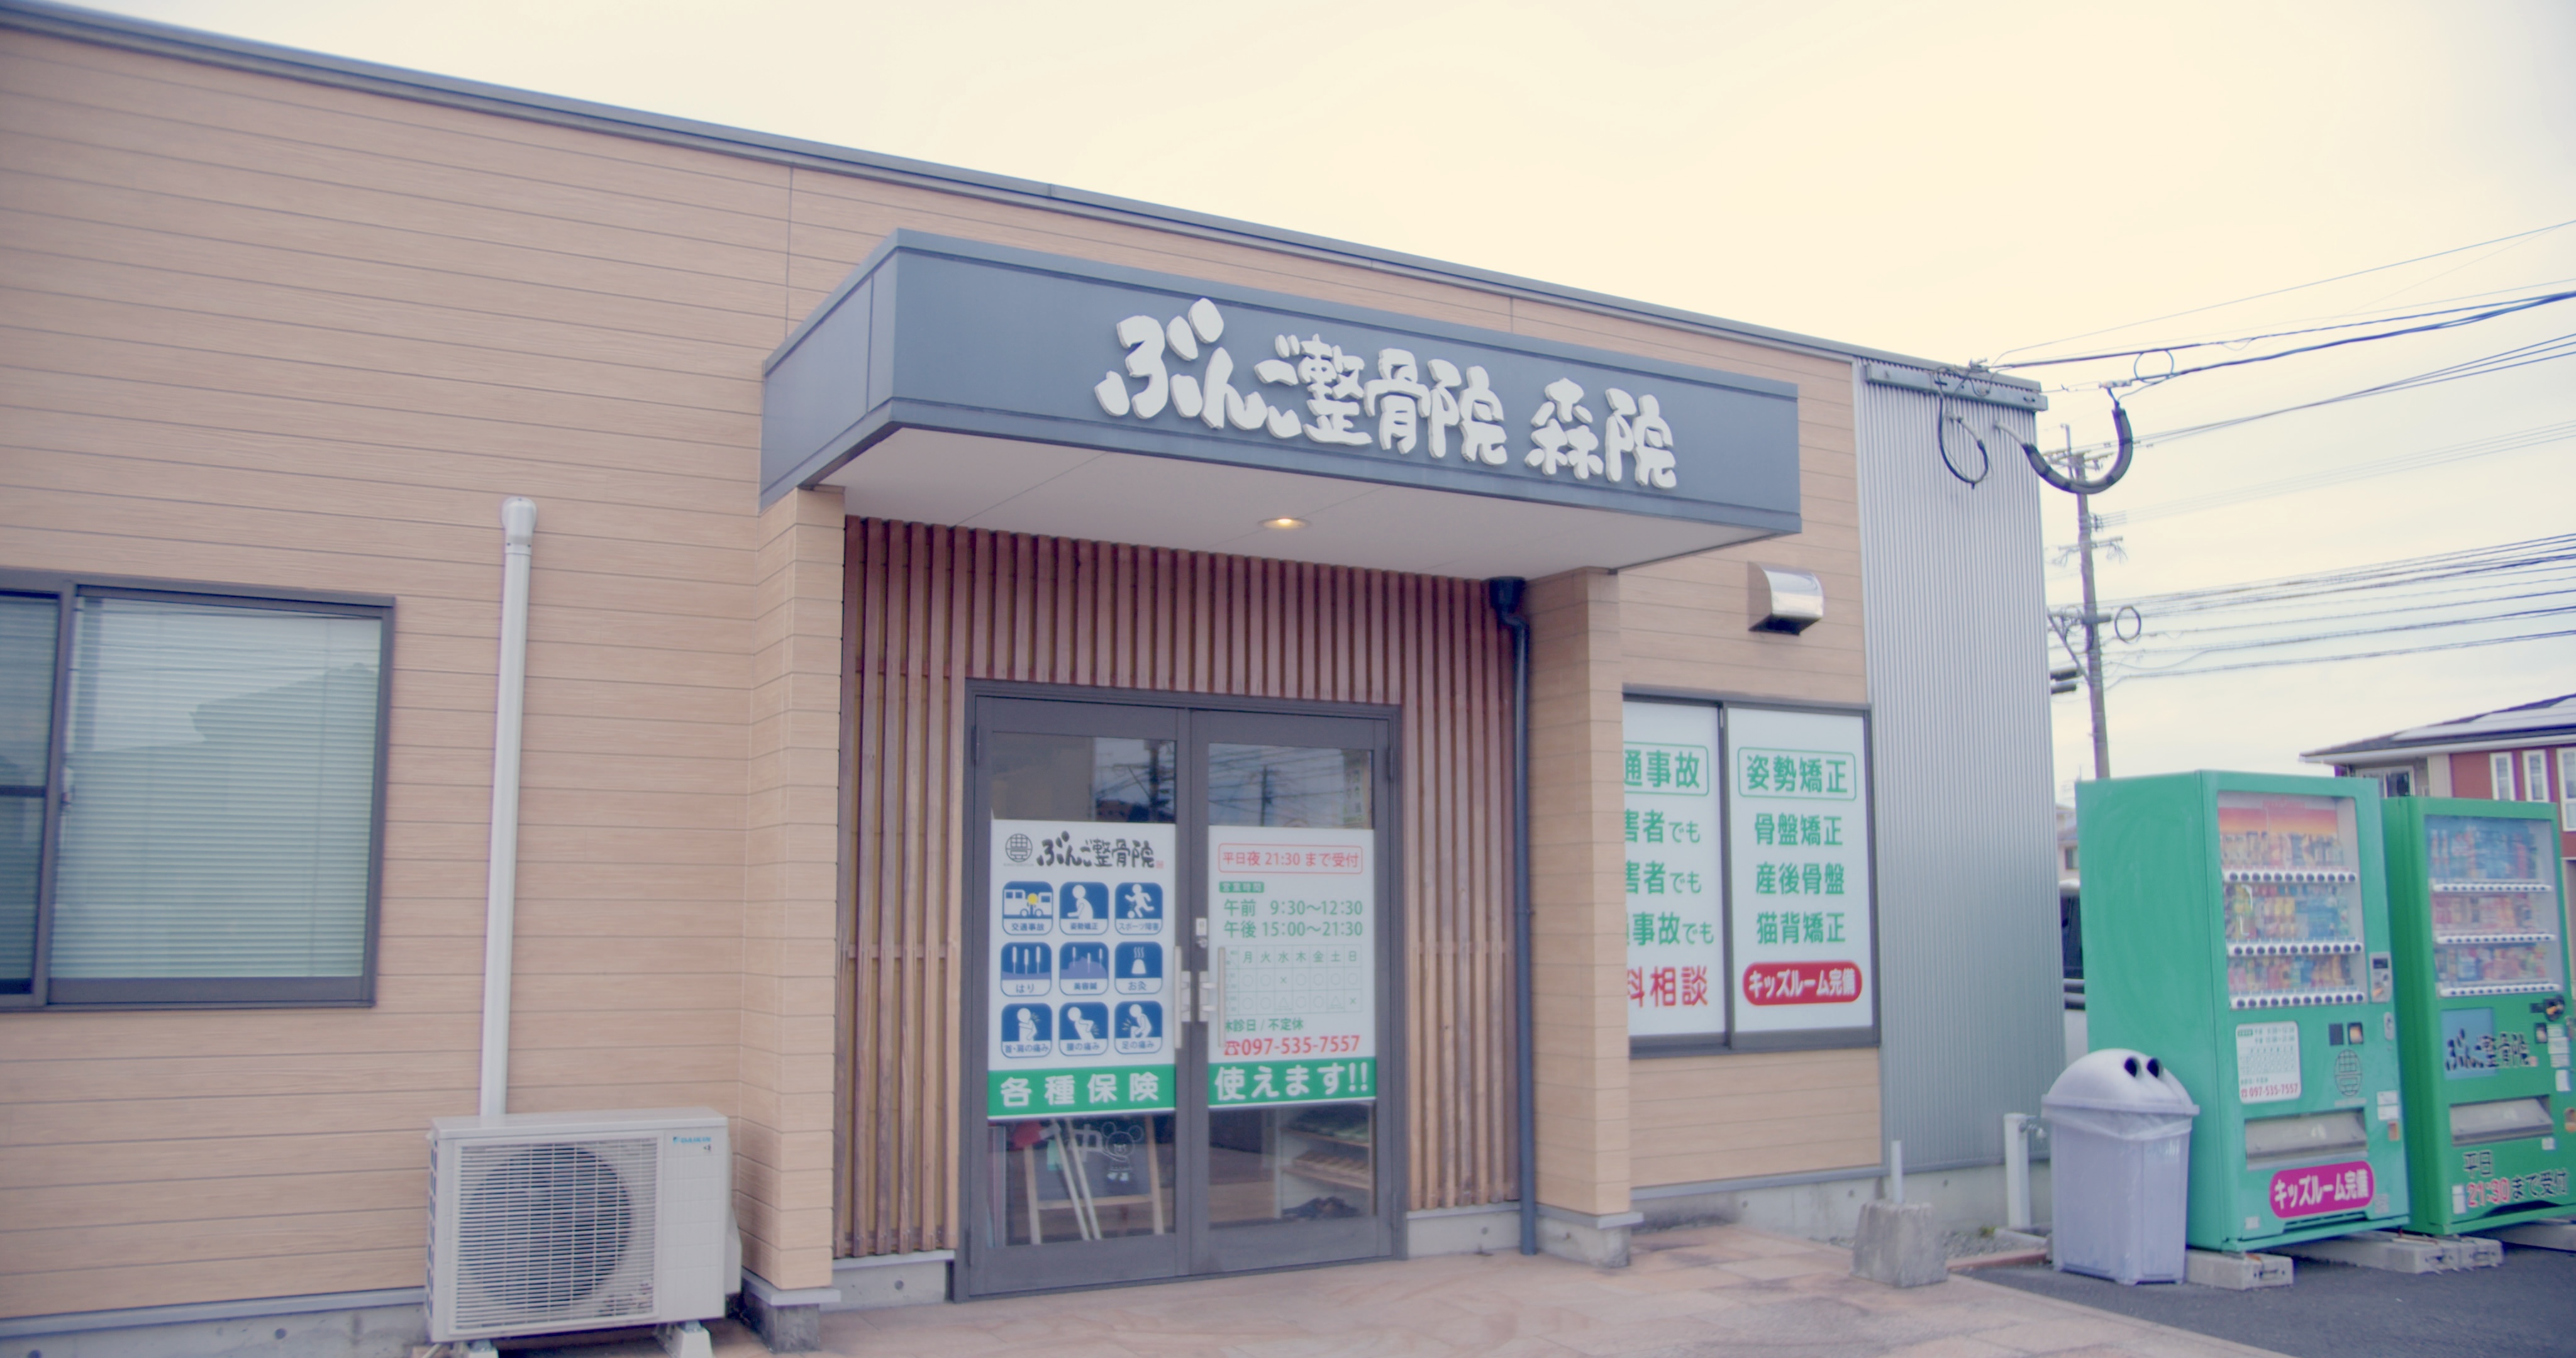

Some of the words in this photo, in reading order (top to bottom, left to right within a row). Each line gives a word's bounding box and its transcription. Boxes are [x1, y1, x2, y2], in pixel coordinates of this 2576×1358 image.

[1094, 297, 1507, 466] ぶんご整骨院
[1524, 378, 1678, 489] 森院
[1624, 749, 1700, 788] 通事故
[1746, 754, 1848, 793] 姿勢矯正
[1755, 813, 1843, 846] 骨盤矯正
[1036, 830, 1155, 868] ぶんご整骨院
[1222, 851, 1261, 867] 平日夜
[1265, 852, 1301, 866] 21:30
[1305, 852, 1360, 868] まで受付
[1755, 861, 1845, 895] 産後骨盤
[1224, 899, 1257, 917] 午前
[1011, 922, 1045, 932] 交通事故
[1224, 920, 1257, 939] 午後
[1626, 911, 1714, 946] 事故でも
[1756, 911, 1846, 945] 猫背矯正
[1243, 951, 1253, 964] 月
[1260, 951, 1271, 963] 火
[1278, 951, 1289, 963] 水
[1296, 951, 1307, 963] 木
[1313, 950, 1324, 963] 金
[1331, 951, 1341, 962] 土
[1348, 950, 1357, 962] 日
[1016, 983, 1035, 993] はり
[1128, 981, 1147, 991] お灸
[1748, 968, 1856, 999] キッズルーム完備
[1268, 1017, 1304, 1032] 不定休
[1122, 1041, 1155, 1050] 足の痛み
[1241, 1035, 1360, 1056] 097-535-7557
[1001, 1071, 1159, 1107] 各種保険
[1214, 1062, 1368, 1101] 使えます!!
[2463, 1150, 2492, 1179] 平日
[2273, 1169, 2369, 1210] キッズルーム完備
